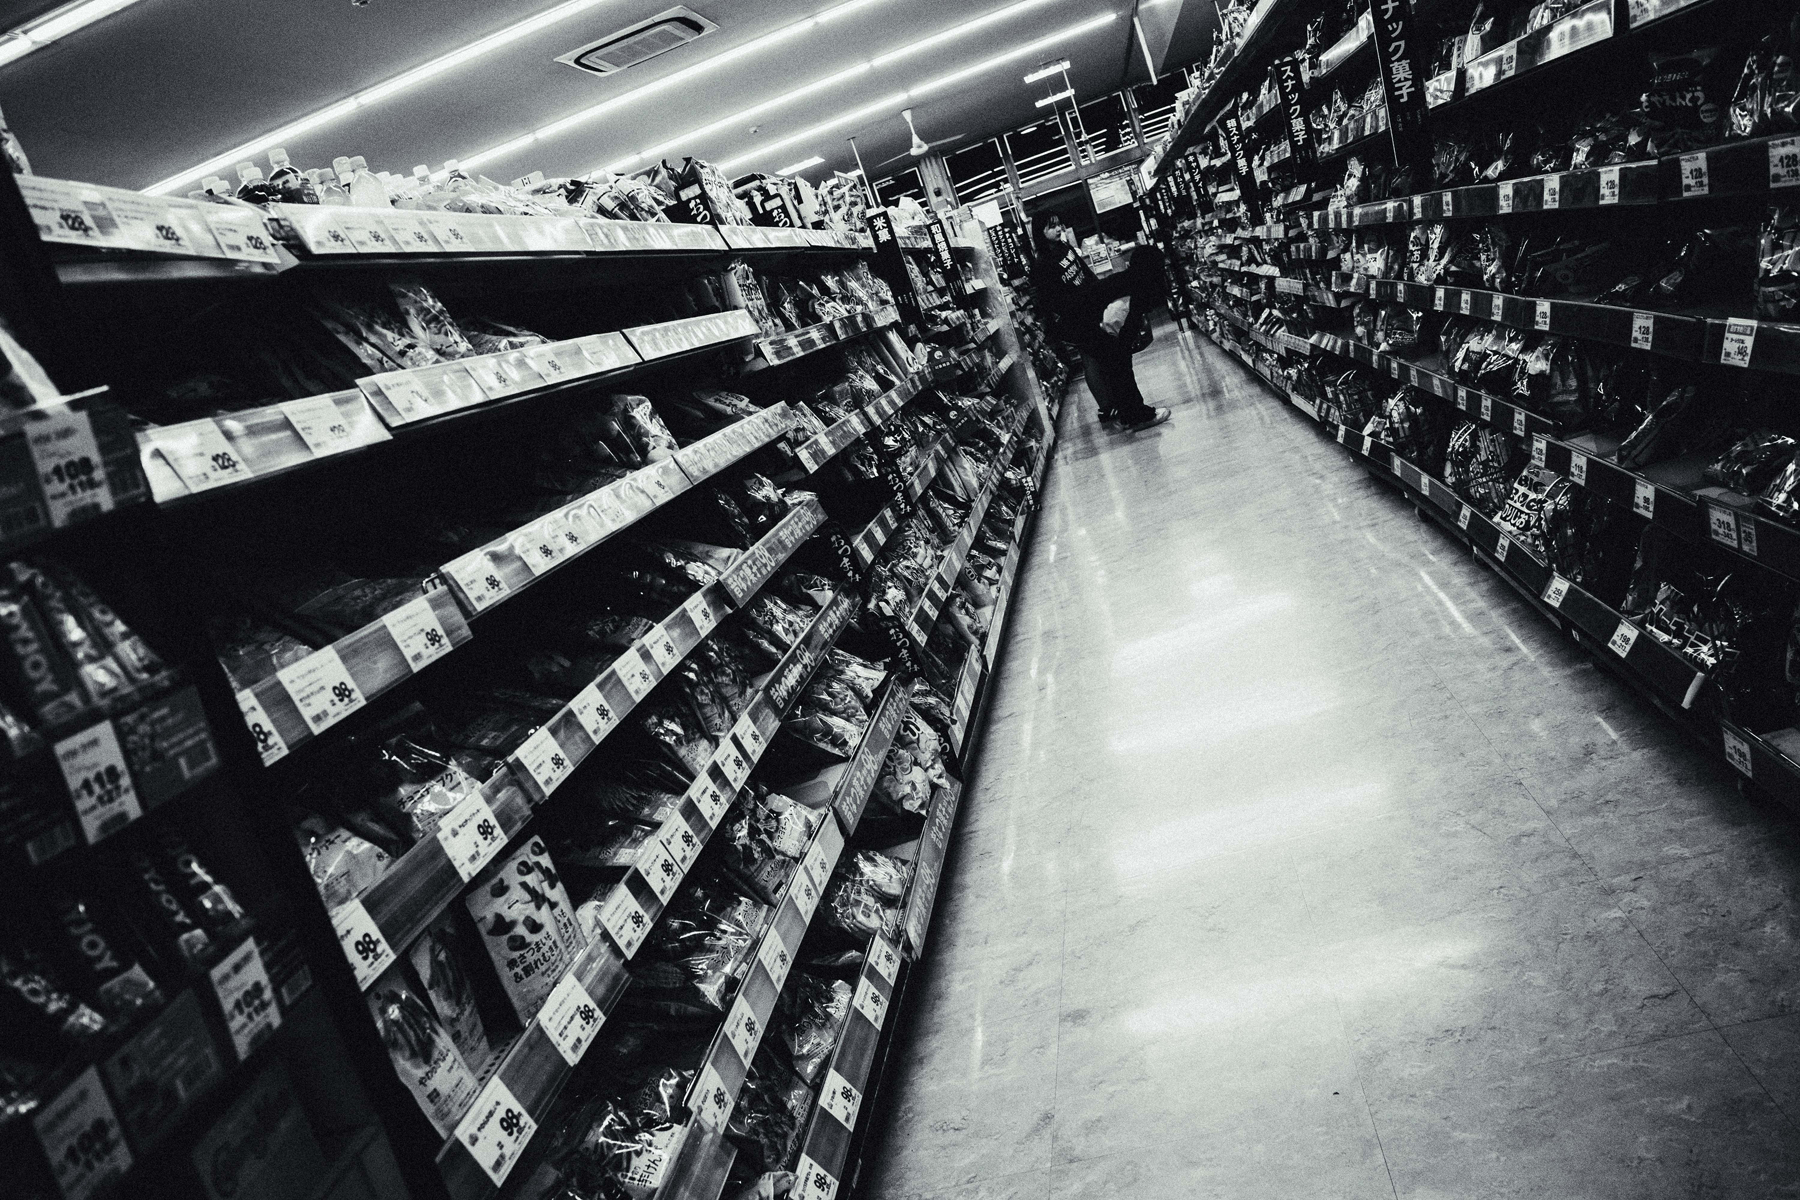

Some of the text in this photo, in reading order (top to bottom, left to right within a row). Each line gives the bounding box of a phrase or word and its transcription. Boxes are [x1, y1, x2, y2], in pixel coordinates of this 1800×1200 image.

[1280, 64, 1308, 146] スナック菓子
[1187, 154, 1204, 196] キャンディー
[1780, 155, 1798, 169] 128
[872, 214, 891, 244] 米菓
[212, 452, 235, 470] 128
[887, 473, 912, 515] おつまみ
[800, 506, 817, 529] 98
[1501, 504, 1530, 529] のりしお
[1717, 518, 1731, 533] 318
[755, 545, 775, 572] 98
[830, 534, 861, 583] おつまみ
[485, 574, 500, 590] 98
[425, 628, 441, 646] 98
[889, 627, 920, 673] おつまみ
[796, 644, 815, 673] 98
[332, 682, 351, 702] 98
[252, 722, 268, 744] 8
[861, 747, 878, 777] 98
[477, 818, 494, 841] 98
[354, 933, 377, 960] 98
[506, 931, 552, 972] 焼さつまいも
[580, 1004, 594, 1025] 98
[500, 1108, 519, 1137] 98
